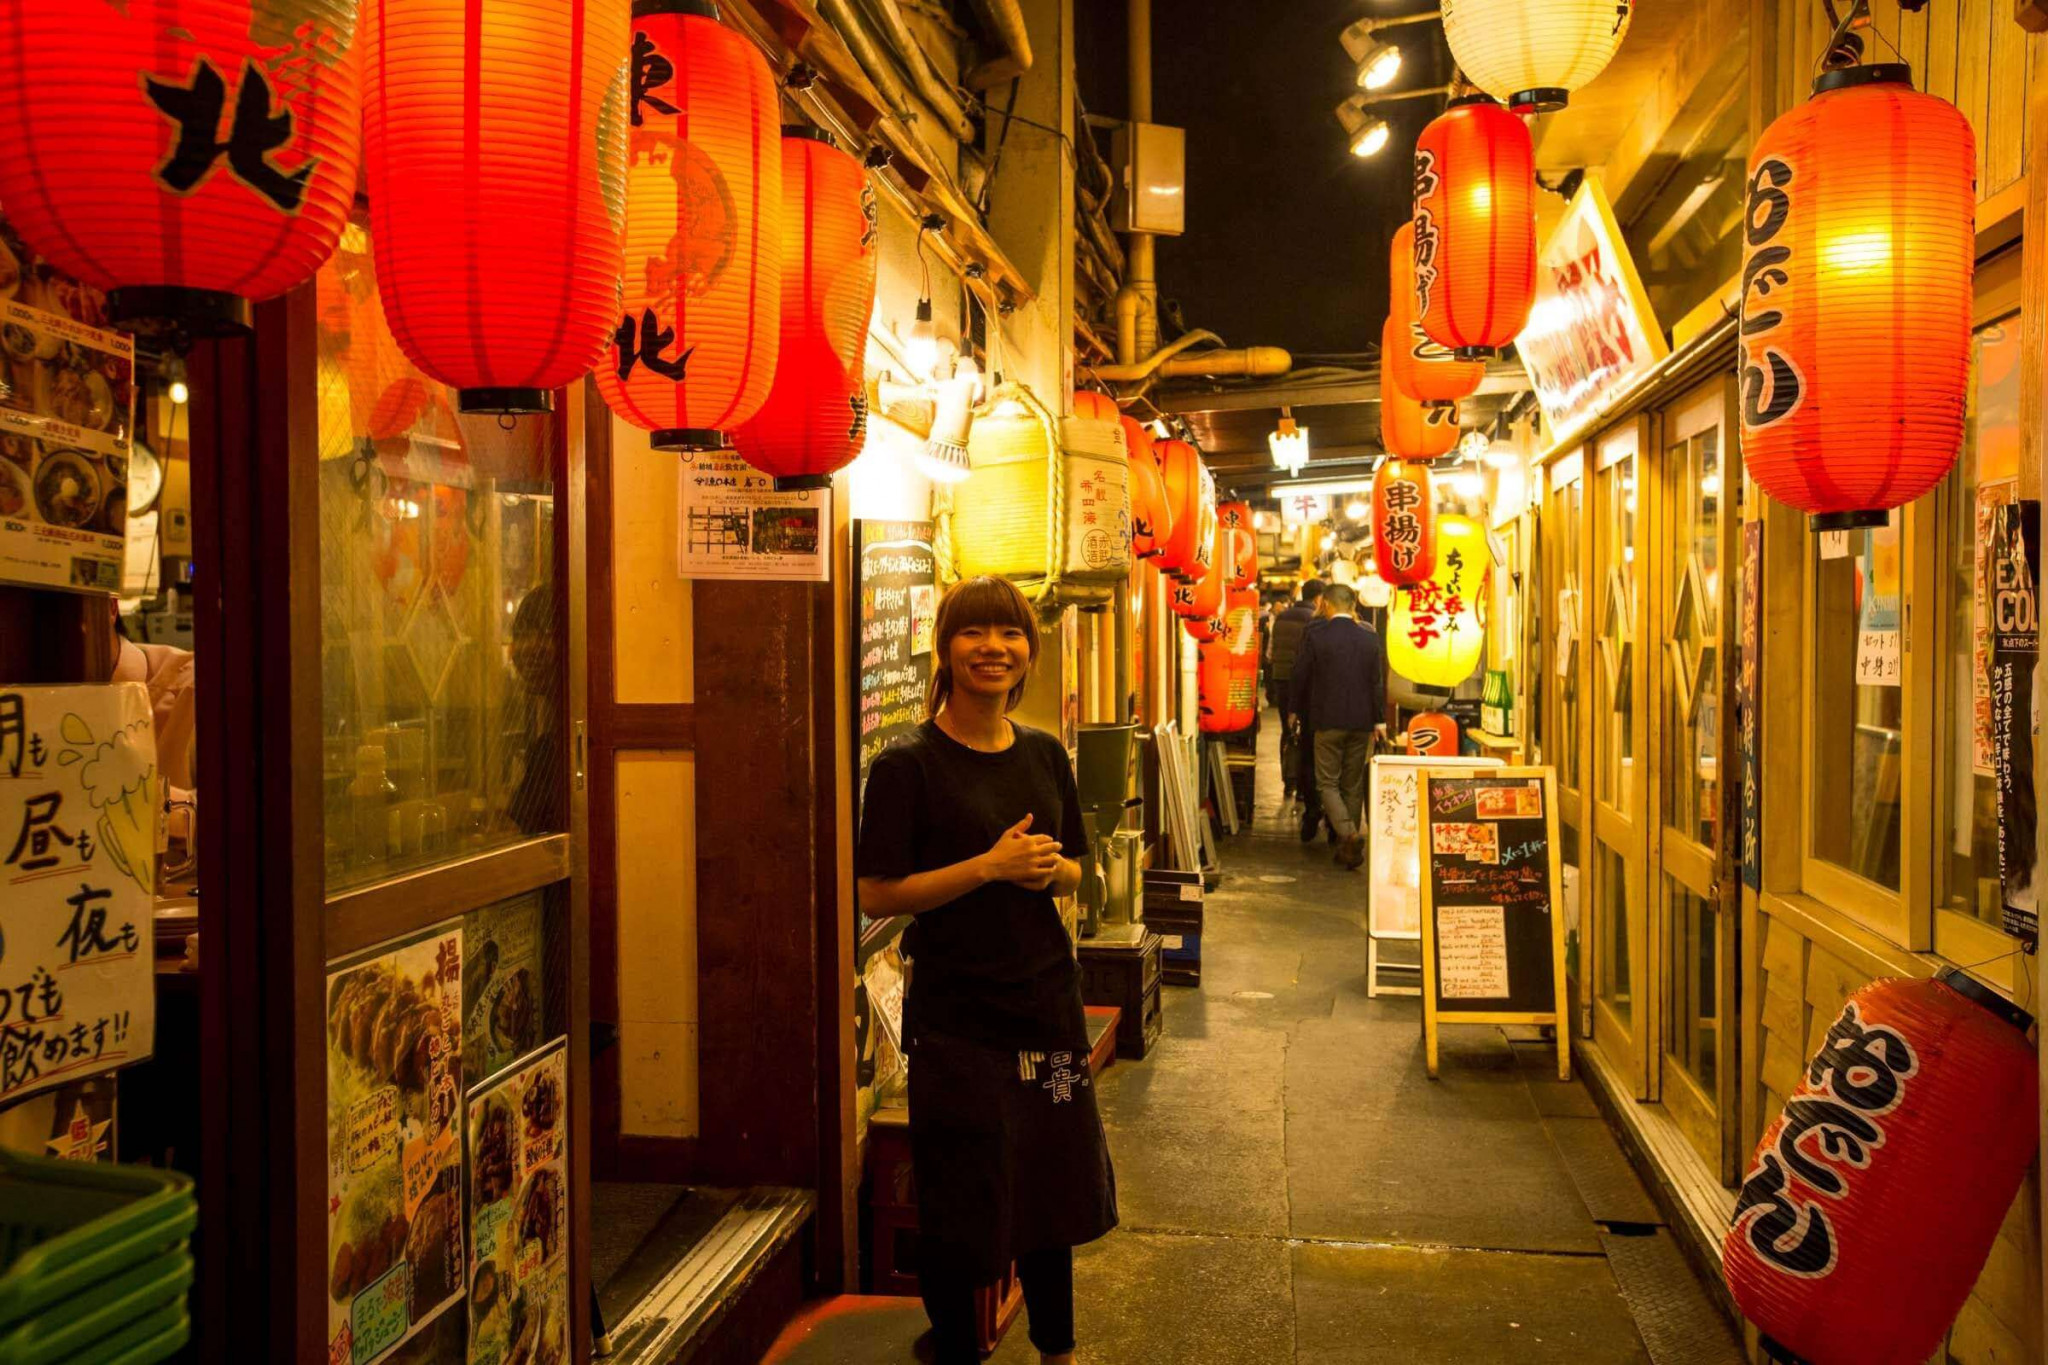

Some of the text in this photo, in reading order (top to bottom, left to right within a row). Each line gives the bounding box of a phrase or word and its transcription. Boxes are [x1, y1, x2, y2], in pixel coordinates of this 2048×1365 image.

[140, 54, 320, 215] 北
[613, 307, 695, 382] 北
[1384, 482, 1422, 569] 串揚げ
[1174, 588, 1194, 605] 北
[1406, 581, 1443, 649] 餃子
[1442, 547, 1464, 632] ちょい呑み
[1861, 656, 1885, 678] 中身
[5, 792, 95, 870] 昼も
[57, 884, 140, 963] 夜も
[0, 1011, 130, 1090] 飲めます!!
[1731, 1004, 1912, 1273] おでん
